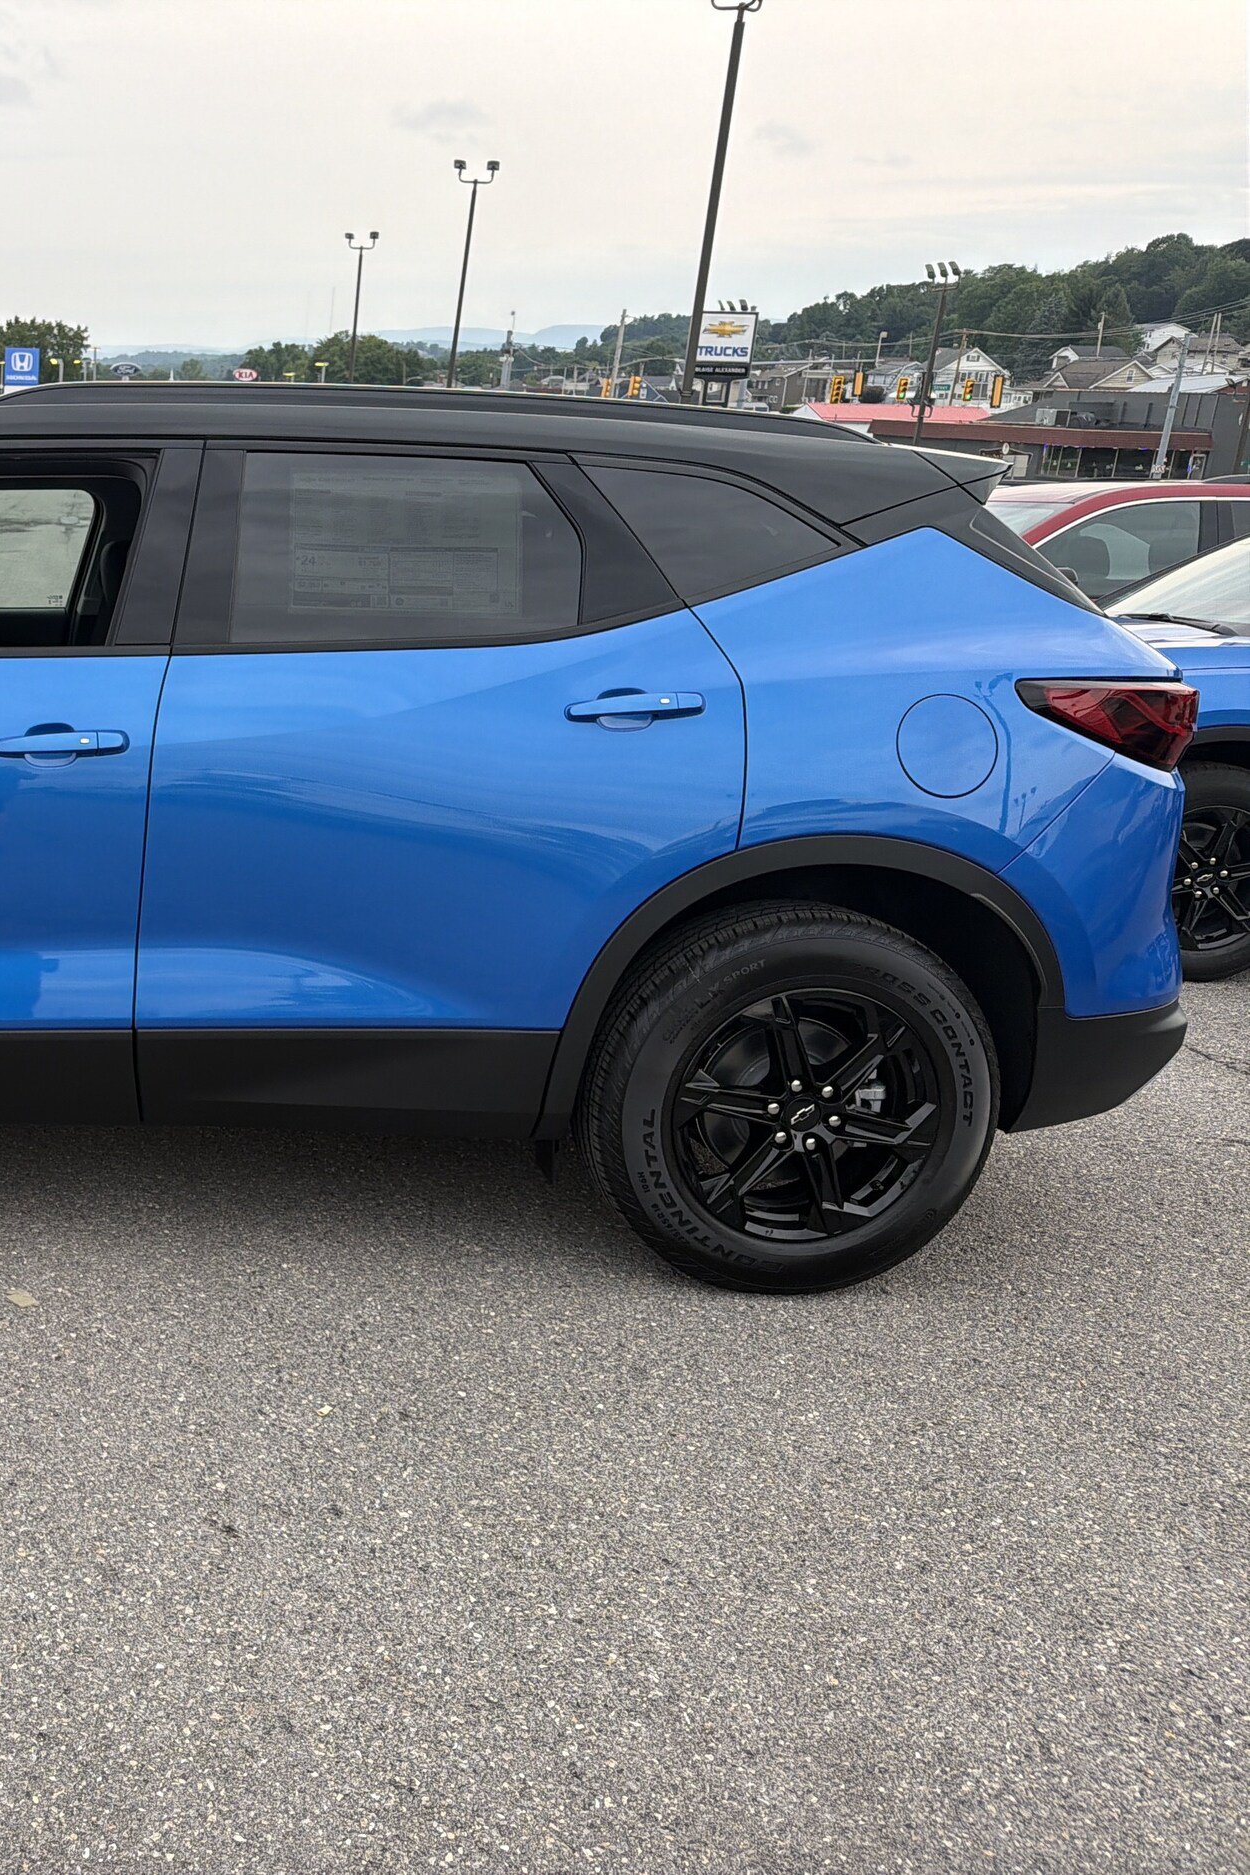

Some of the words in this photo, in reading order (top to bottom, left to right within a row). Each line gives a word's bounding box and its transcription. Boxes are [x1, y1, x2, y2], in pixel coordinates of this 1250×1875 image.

[698, 345, 749, 357] TRUCKS
[238, 371, 254, 379] KIA
[723, 959, 766, 982] SPORT
[930, 1009, 974, 1127] CONTACT
[642, 1108, 785, 1274] CONTINENTAL
